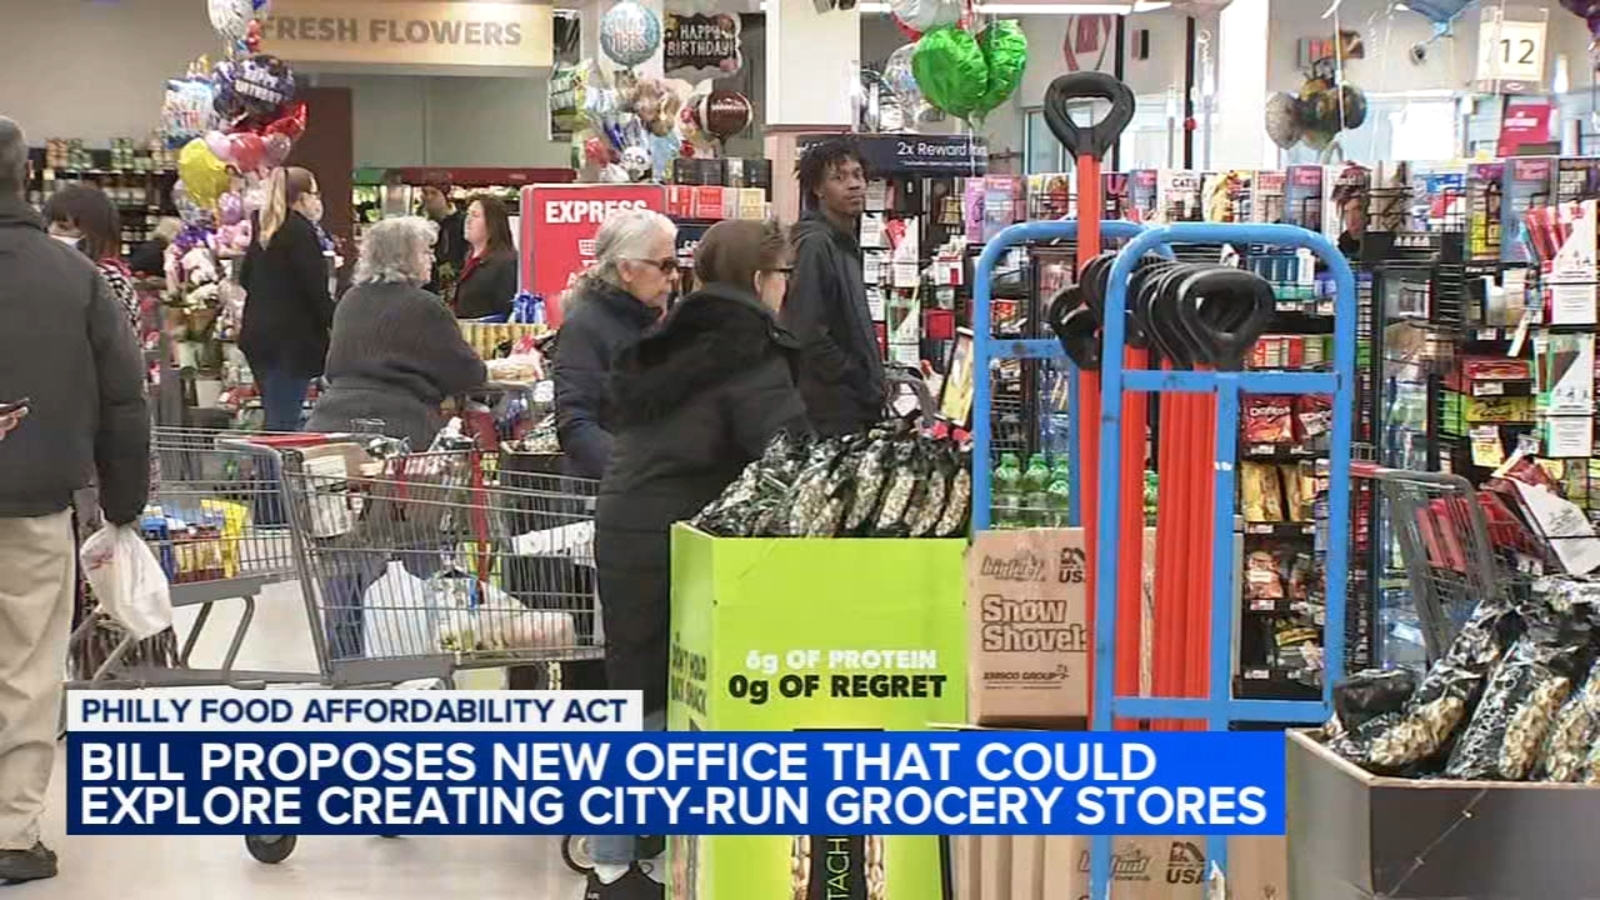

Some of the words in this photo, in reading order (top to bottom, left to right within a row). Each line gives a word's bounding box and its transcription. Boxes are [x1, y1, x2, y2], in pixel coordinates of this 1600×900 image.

[262, 16, 358, 42] FRESH
[369, 19, 522, 46] FLOWERS
[680, 24, 721, 40] HAPPY
[667, 40, 735, 56] BIRTHDAY!
[1500, 39, 1535, 64] 12
[897, 142, 914, 156] 2x
[1059, 570, 1086, 583] US
[982, 593, 1067, 623] Snow
[746, 649, 779, 675] 6g
[786, 649, 821, 670] OF
[829, 649, 937, 670] PROTEIN
[728, 674, 768, 705] 0g
[779, 674, 820, 698] OF
[832, 674, 947, 698] REGRET
